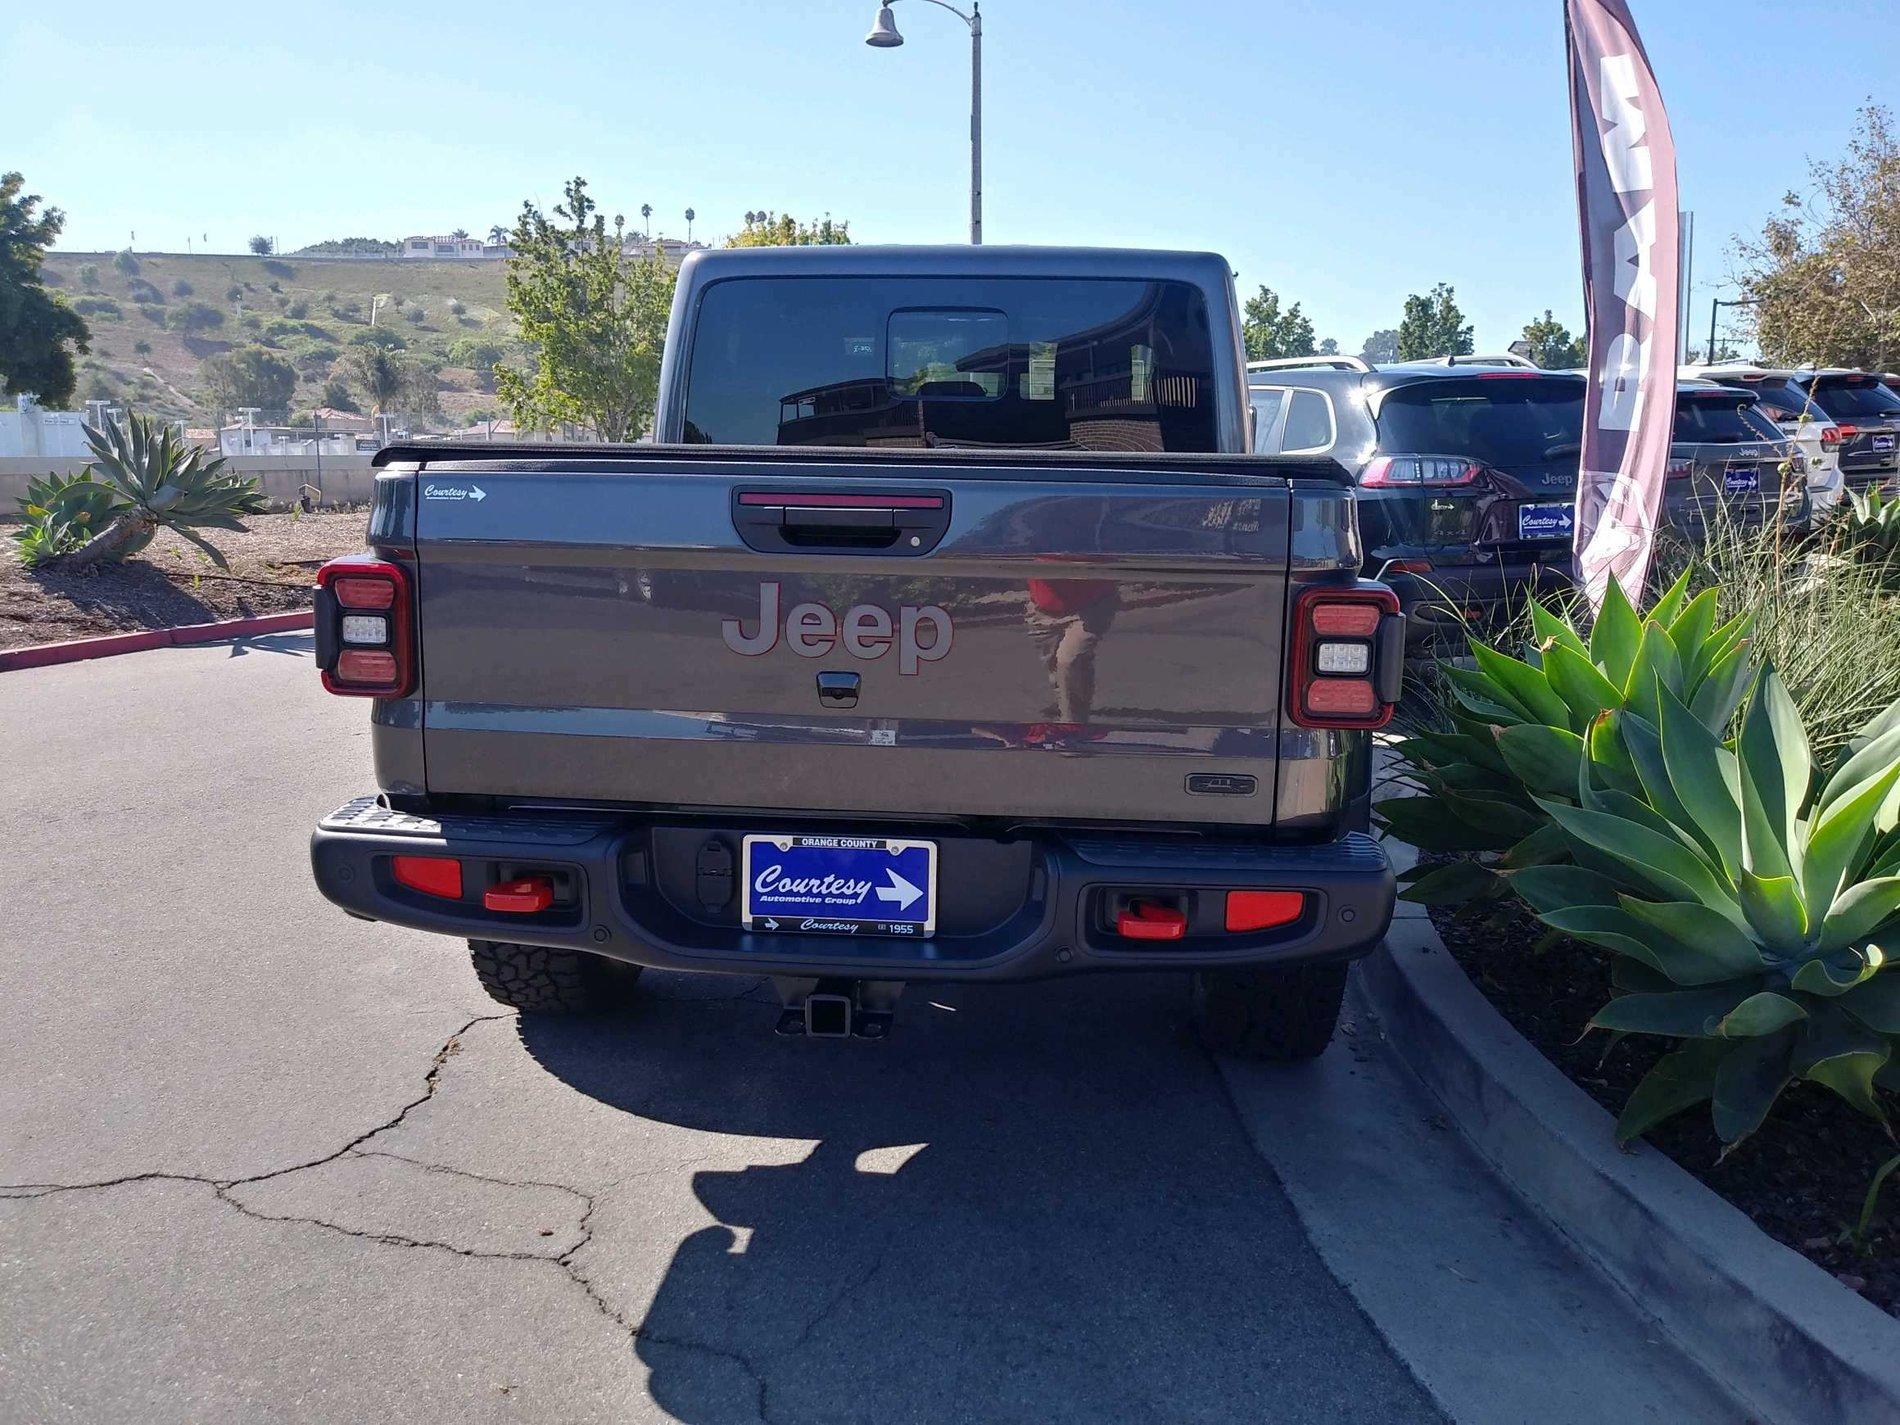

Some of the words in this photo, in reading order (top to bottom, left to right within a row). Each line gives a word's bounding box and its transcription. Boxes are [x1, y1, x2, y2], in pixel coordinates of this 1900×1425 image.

[1598, 53, 1657, 432] RAM
[1541, 472, 1573, 486] Jeep
[424, 484, 468, 500] Courtesy
[1521, 514, 1559, 528] Courtesy
[721, 581, 955, 676] Jeep
[801, 837, 839, 847] ORANGE
[840, 839, 878, 848] COUNTY
[754, 864, 872, 904] Courtesy
[760, 895, 822, 904] Automotive
[824, 897, 857, 906] Group
[800, 918, 859, 933] Courtesy
[889, 924, 914, 934] 1955
